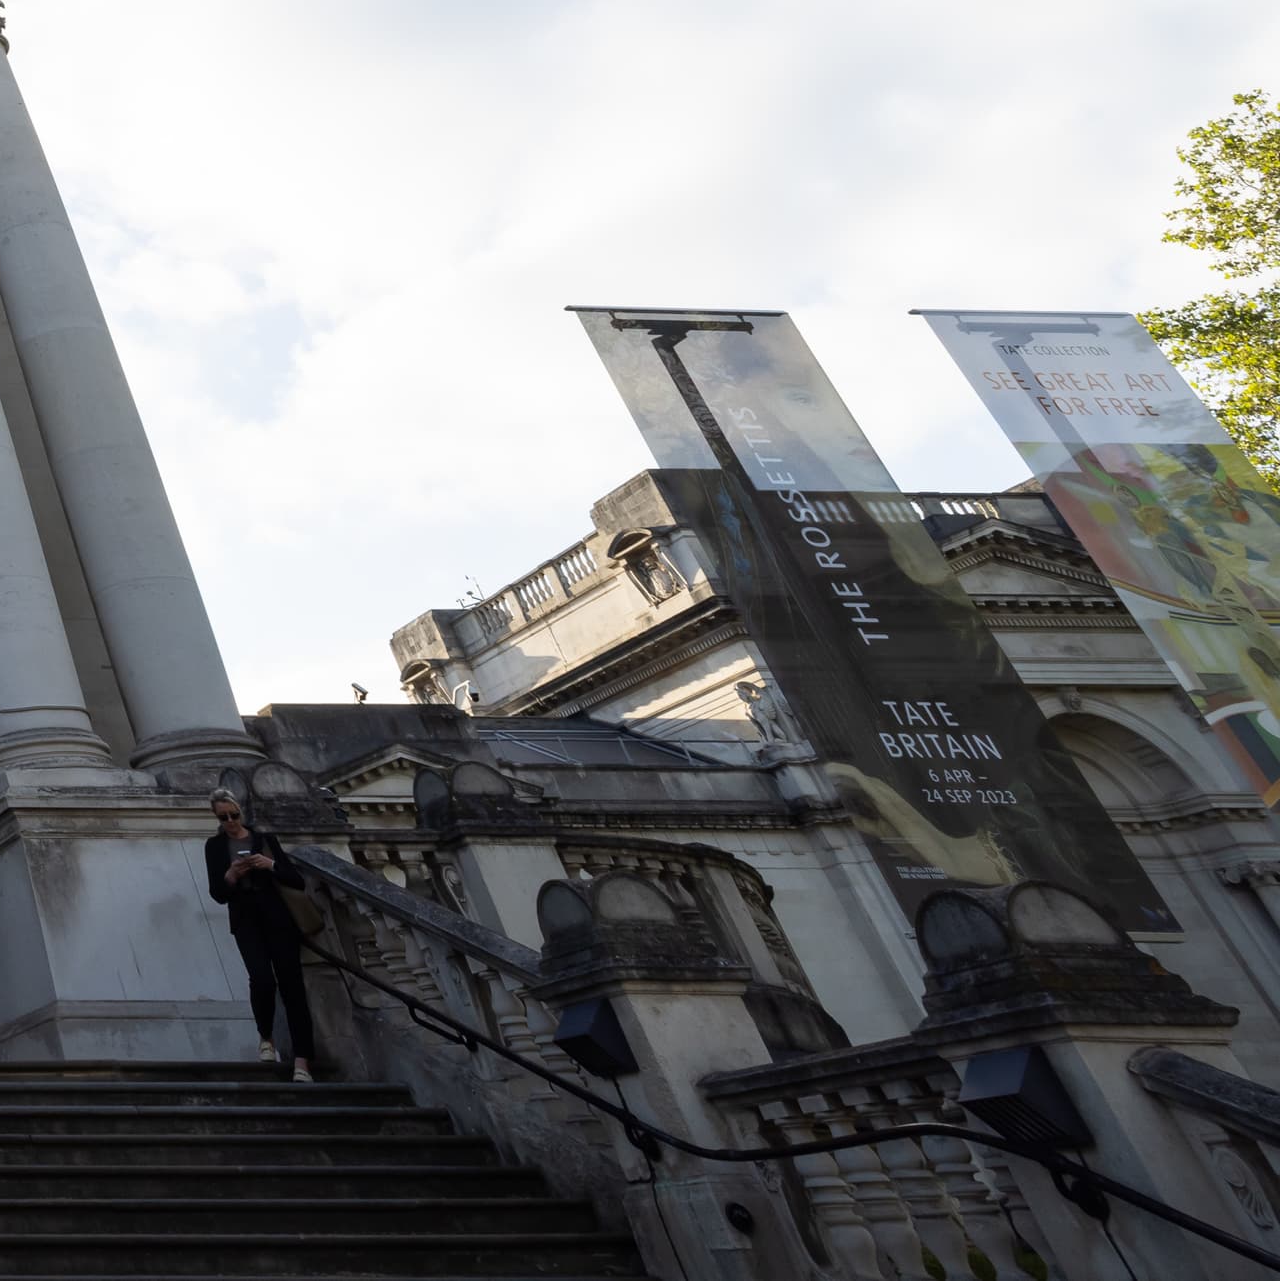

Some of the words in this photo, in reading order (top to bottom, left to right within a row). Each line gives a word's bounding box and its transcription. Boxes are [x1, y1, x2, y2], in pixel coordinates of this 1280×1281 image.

[1000, 344, 1031, 356] TATE
[1032, 345, 1111, 357] COLLECTION
[982, 371, 1032, 391] SEE
[1033, 372, 1116, 392] GREAT
[1124, 373, 1173, 392] ART
[1035, 396, 1093, 416] FOR
[1093, 396, 1160, 417] FREE
[728, 406, 847, 568] ROSSETTIS
[831, 582, 889, 646] THE
[882, 700, 960, 727] TATE
[879, 732, 1003, 760] BRITAIN
[928, 769, 940, 783] 6
[943, 769, 976, 784] APR
[922, 789, 943, 803] 24
[945, 789, 973, 804] SEP
[975, 789, 1017, 805] 2023
